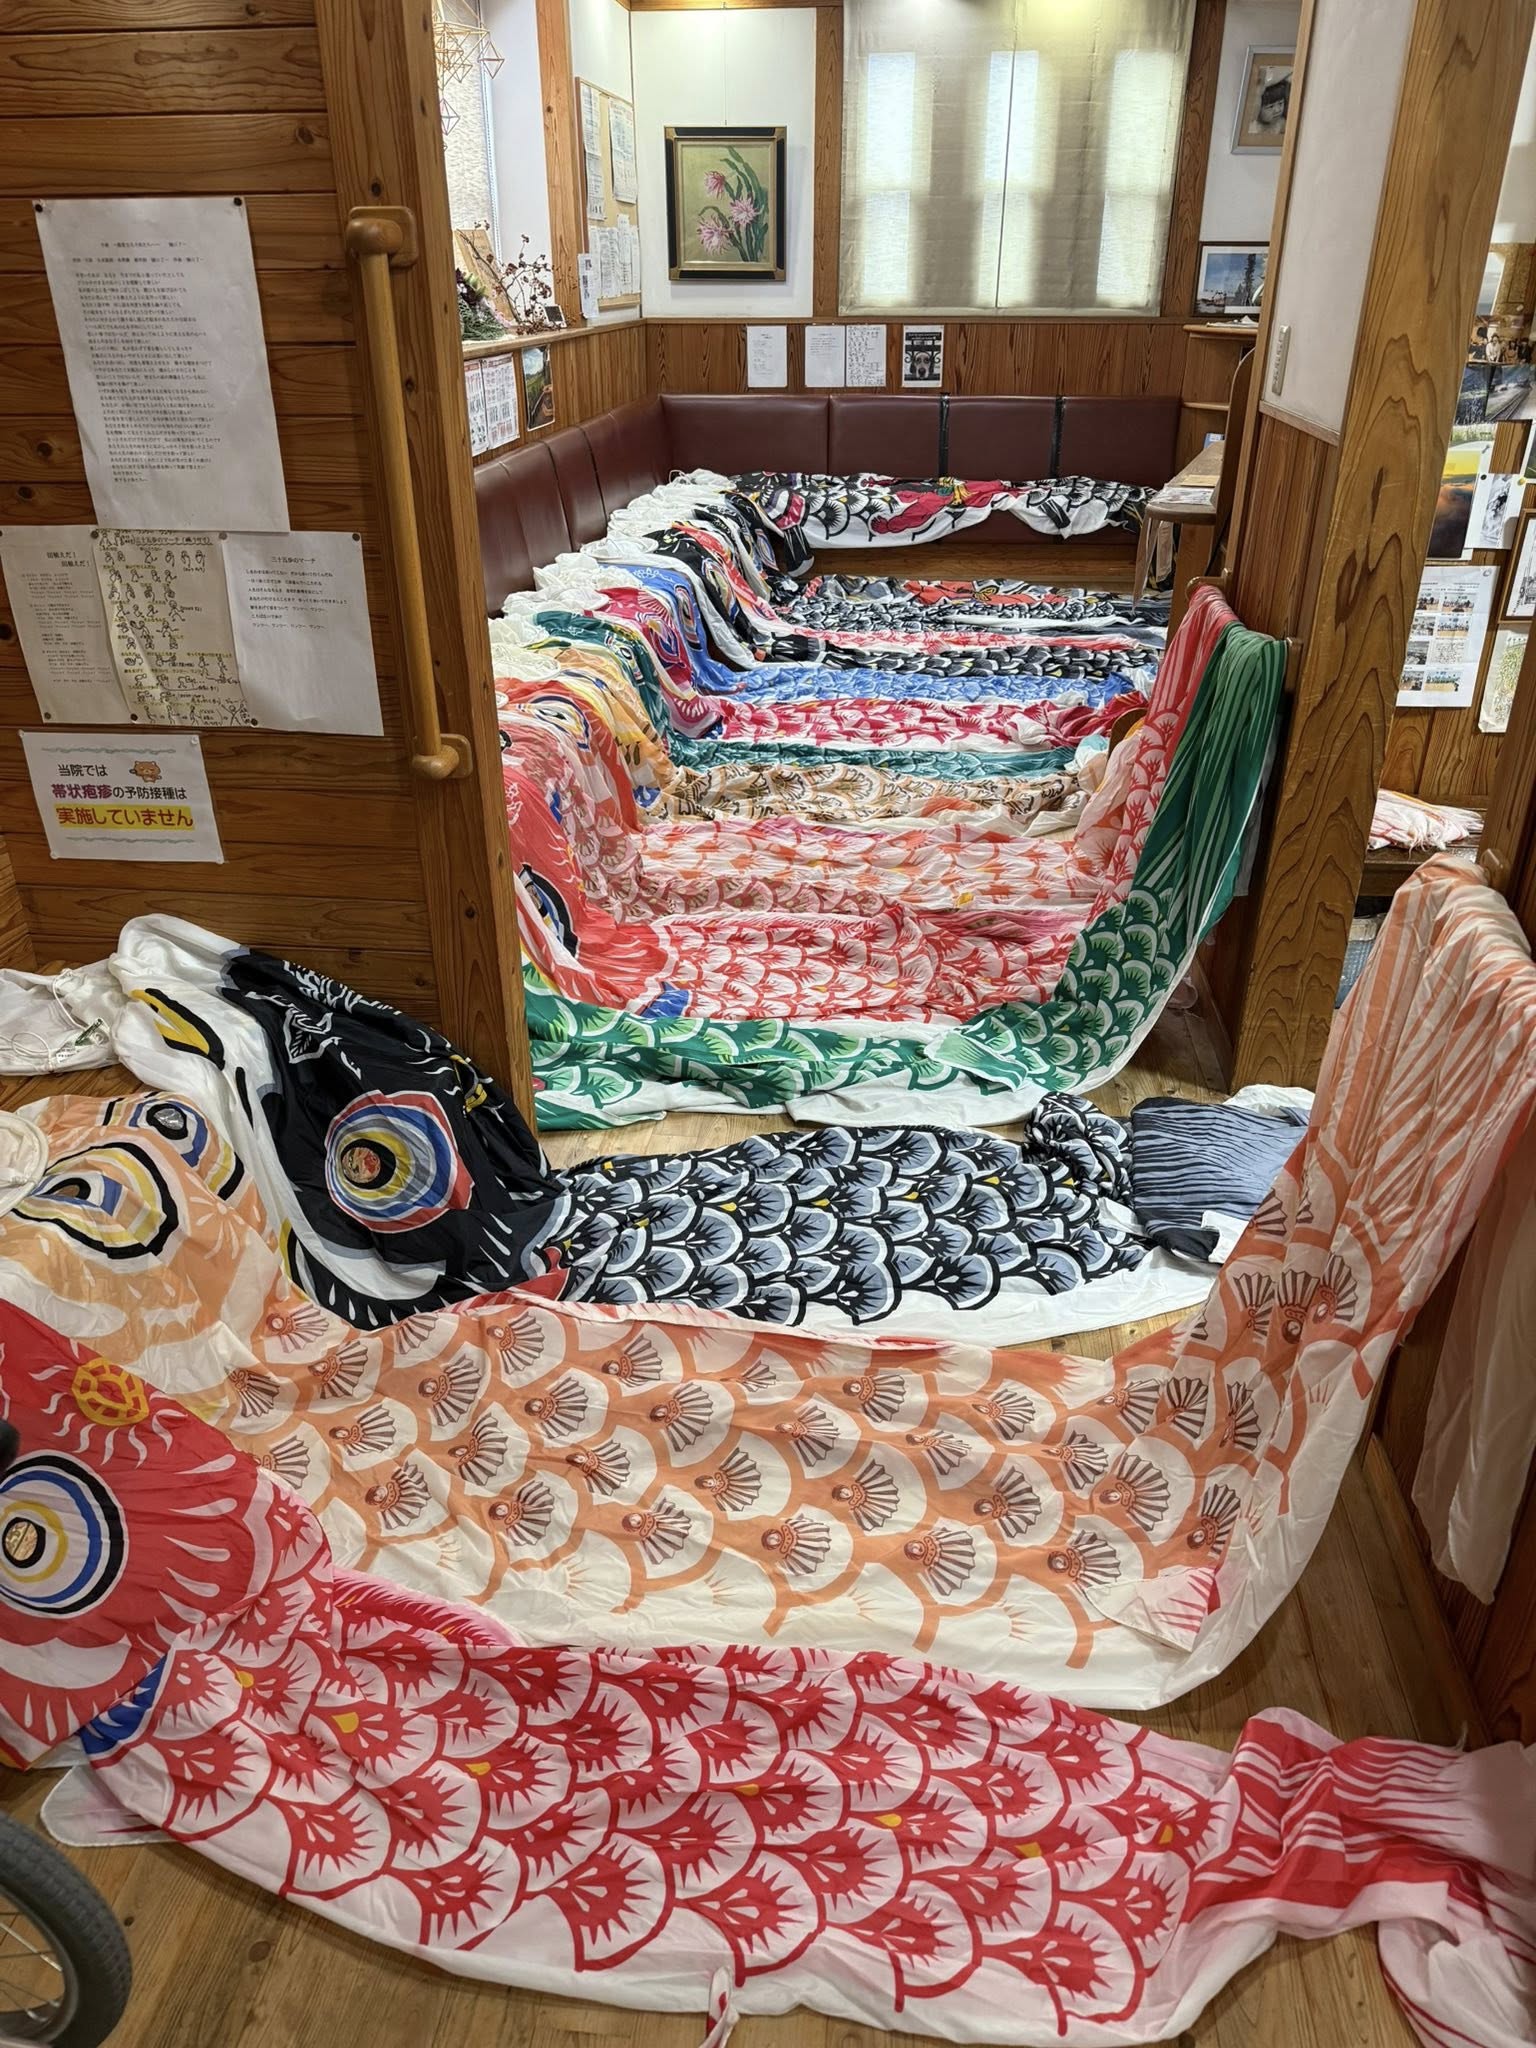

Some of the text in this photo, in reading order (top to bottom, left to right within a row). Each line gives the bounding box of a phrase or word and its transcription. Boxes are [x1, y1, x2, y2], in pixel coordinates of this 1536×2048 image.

[58, 764, 108, 777] 当院では
[51, 783, 187, 800] 帯状疱疹の予防接種は
[56, 807, 194, 827] 実施していません
